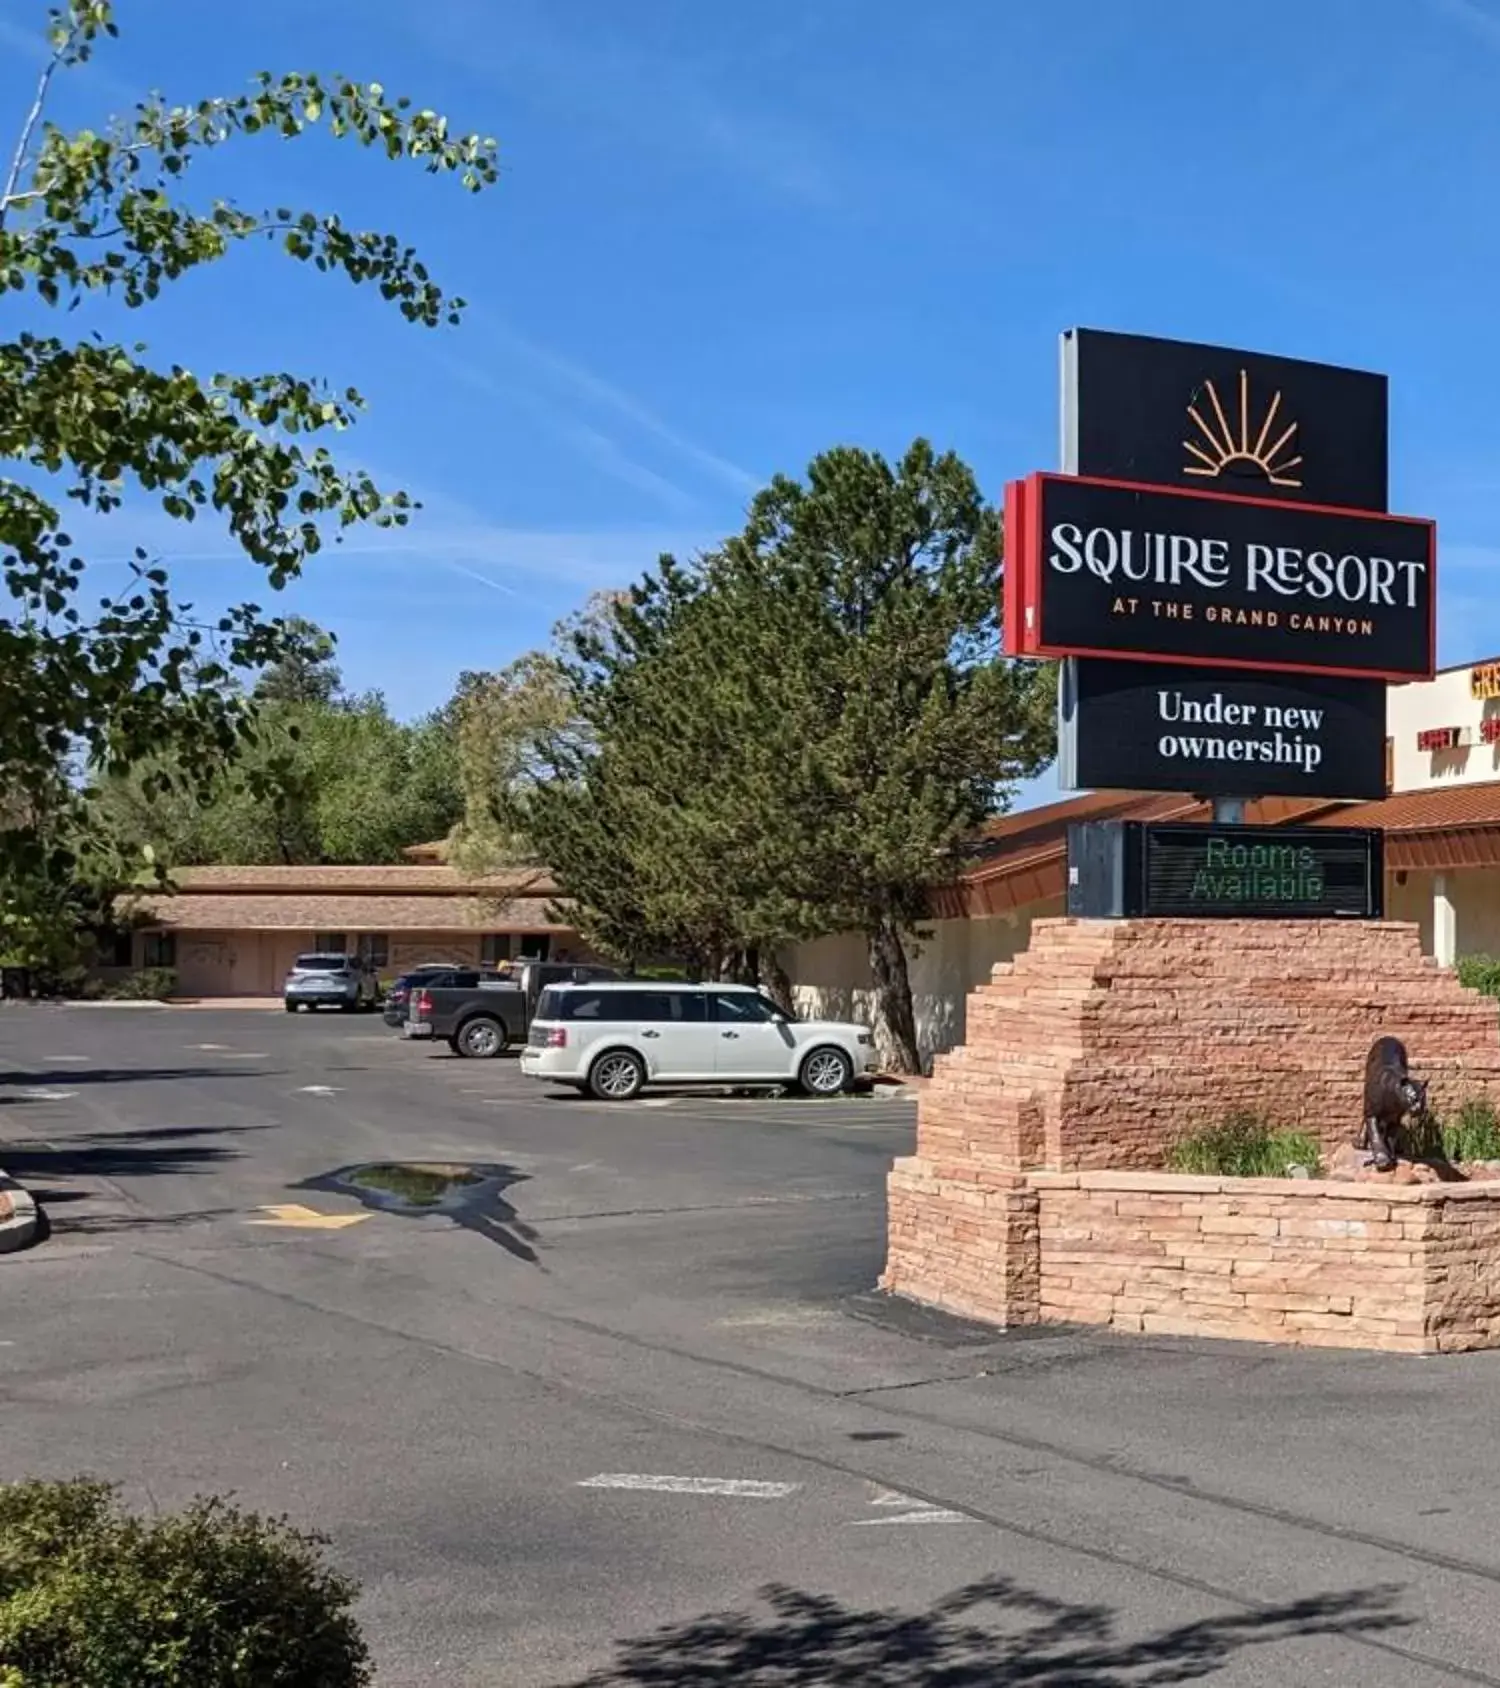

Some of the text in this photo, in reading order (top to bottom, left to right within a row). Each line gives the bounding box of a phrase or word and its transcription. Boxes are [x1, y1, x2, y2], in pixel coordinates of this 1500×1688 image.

[1049, 523, 1426, 608] SQUIRE RESORT
[1113, 597, 1374, 635] AT THE GRAND CANYON
[1157, 690, 1324, 730] Under new
[1159, 732, 1322, 773] ownership
[1206, 838, 1316, 869] Rooms
[1190, 870, 1324, 901] Available
